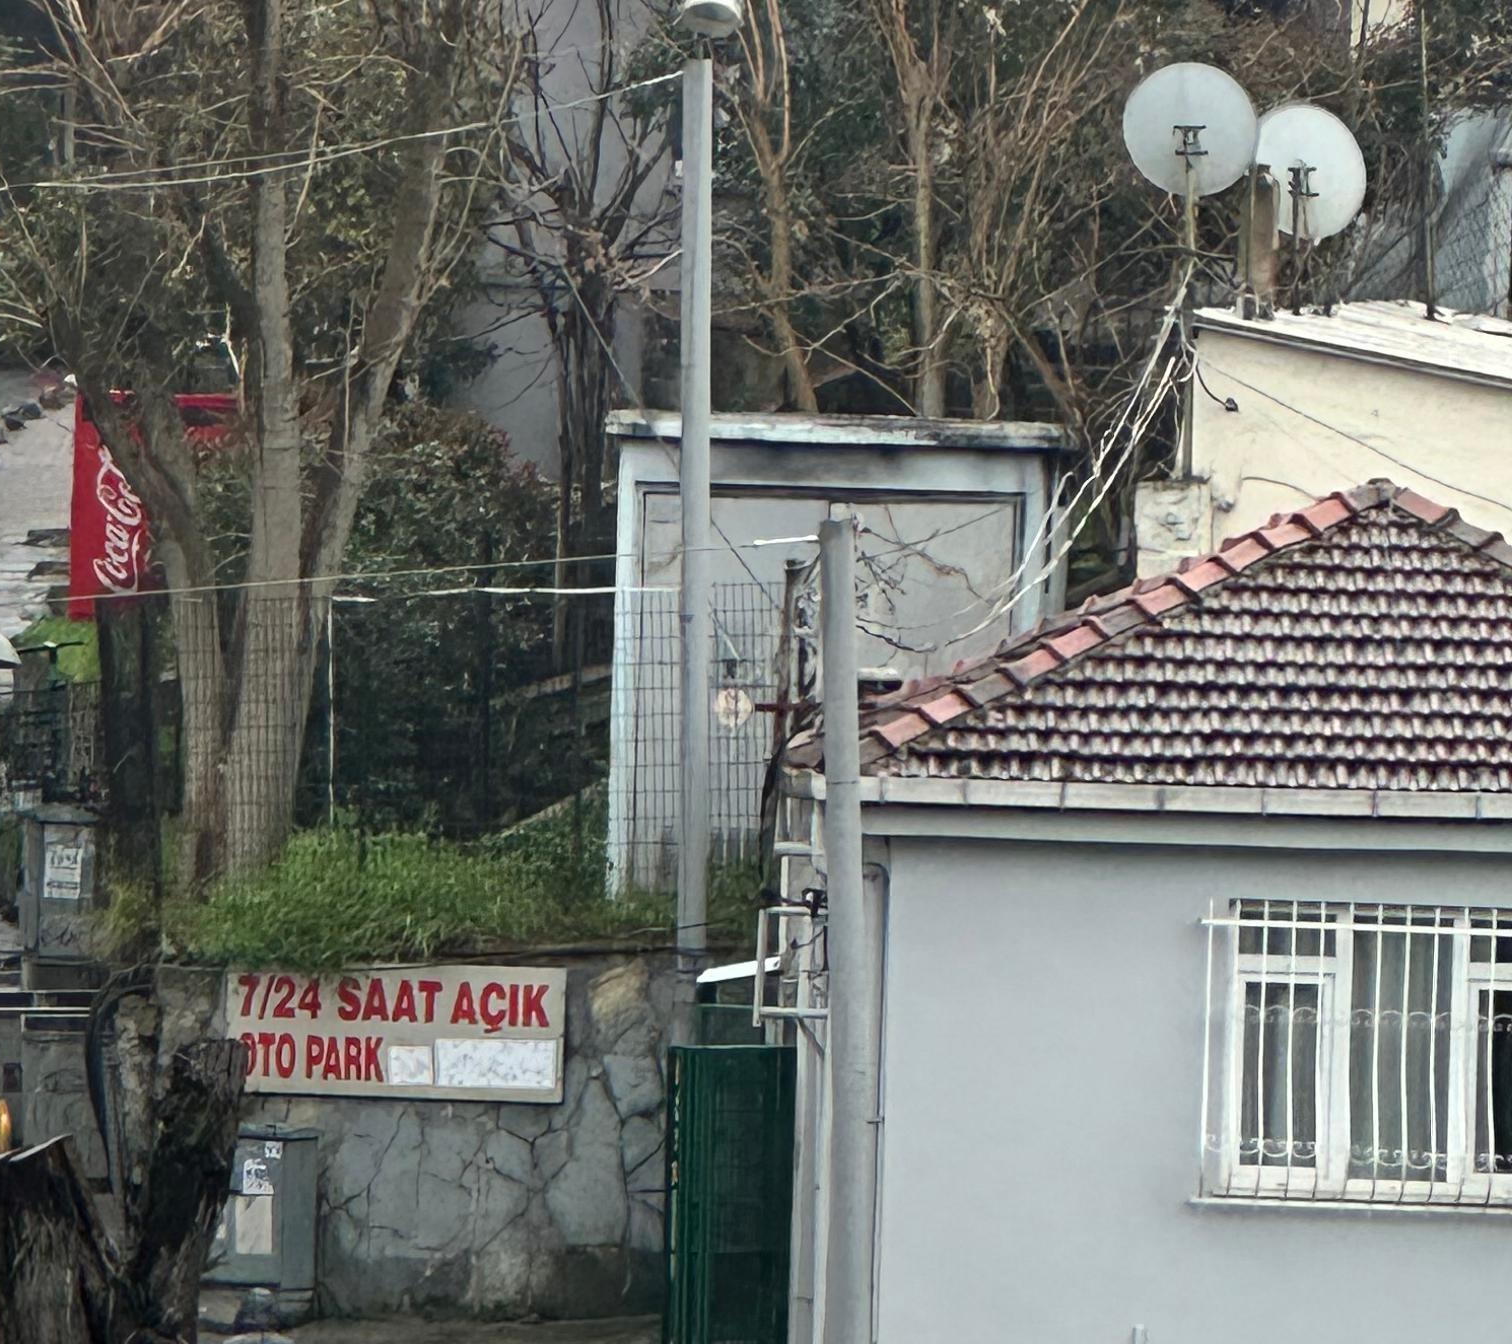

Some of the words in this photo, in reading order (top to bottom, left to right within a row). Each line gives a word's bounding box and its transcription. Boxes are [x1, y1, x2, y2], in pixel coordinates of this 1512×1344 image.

[237, 973, 322, 1020] 7/24
[338, 976, 443, 1023] SAAT
[451, 980, 550, 1033] AÇIK
[305, 1034, 384, 1082] PARK
